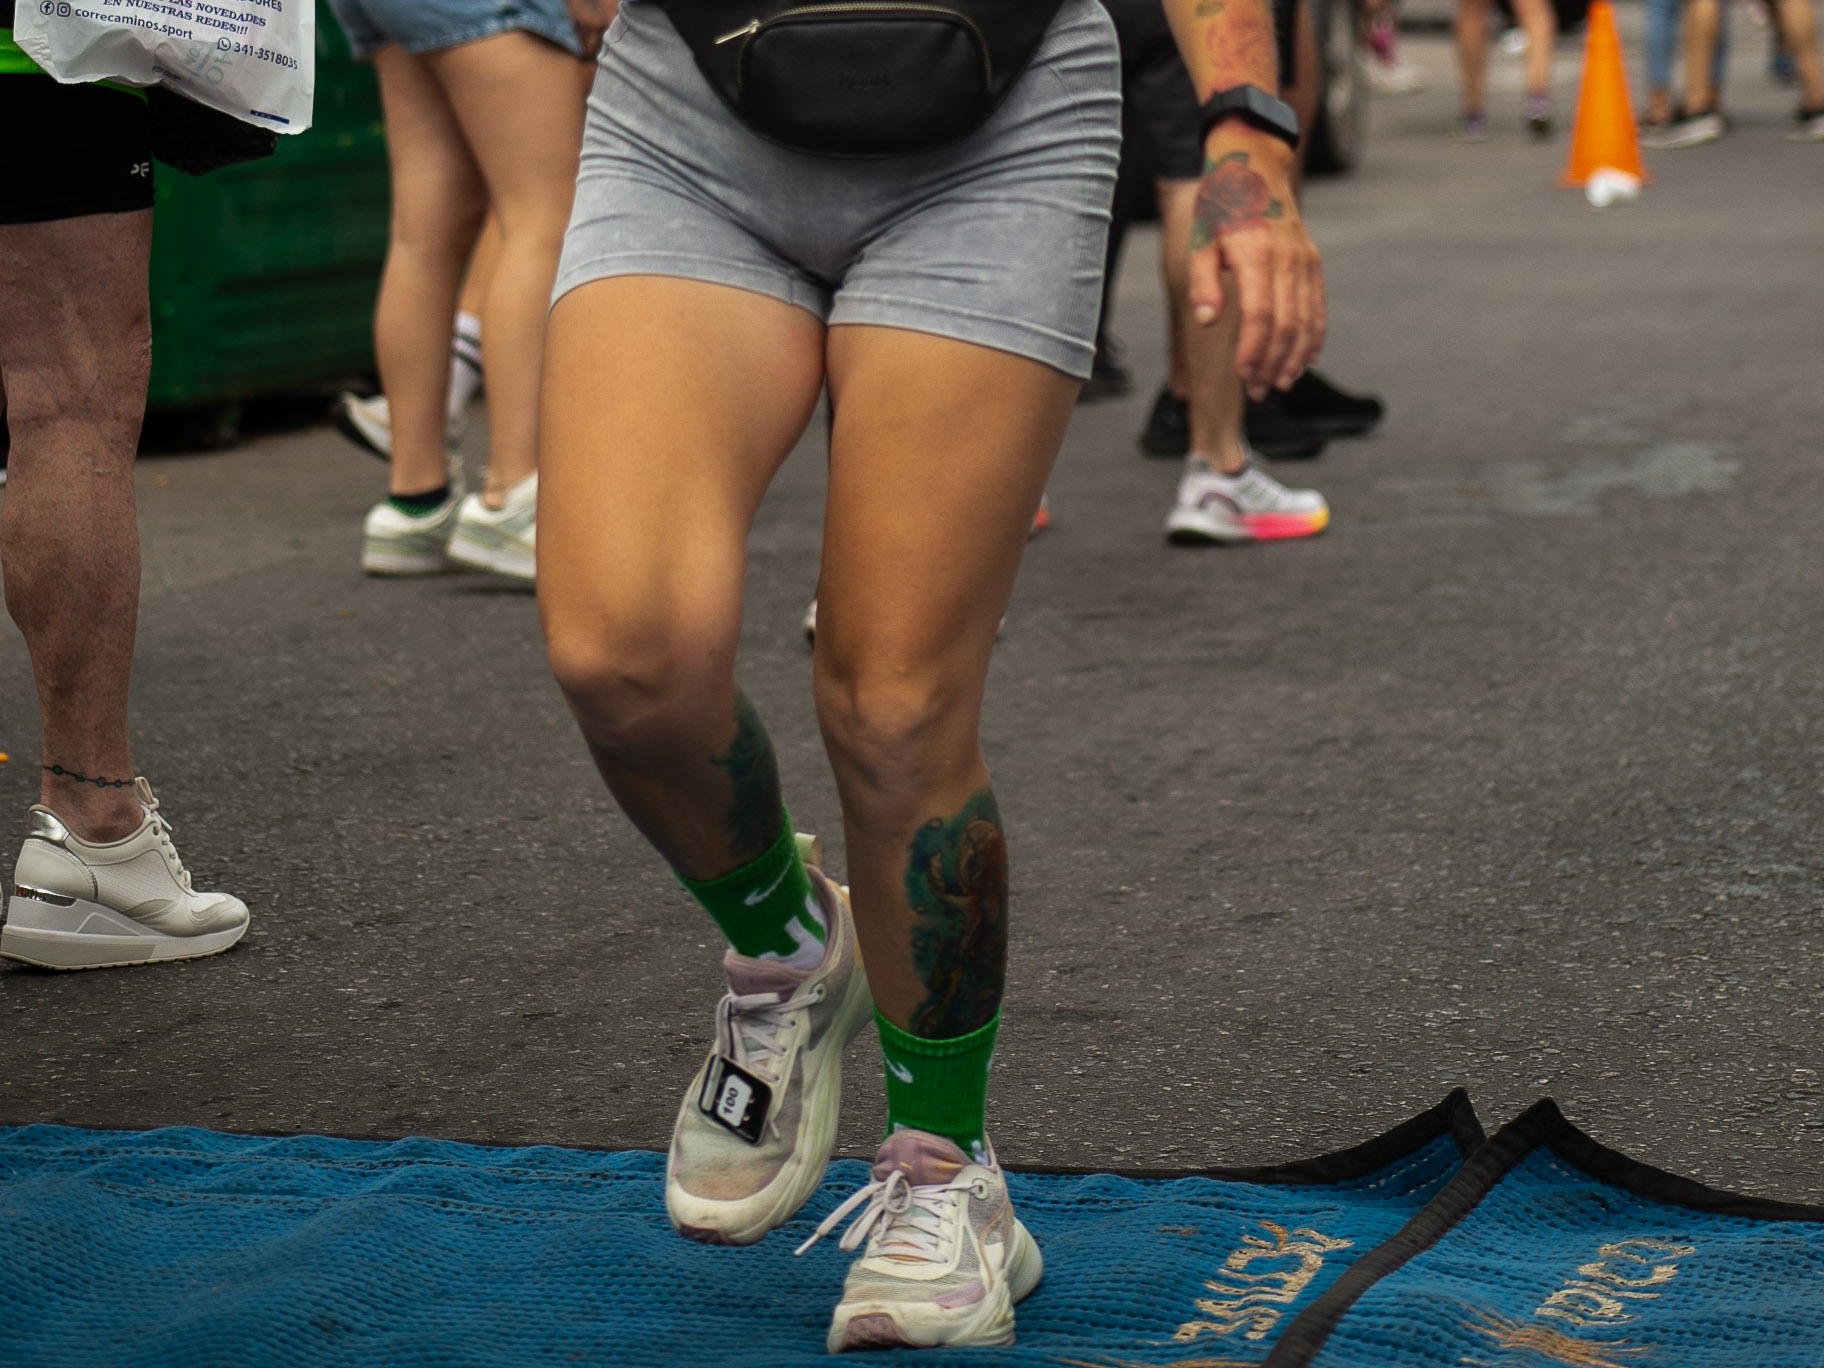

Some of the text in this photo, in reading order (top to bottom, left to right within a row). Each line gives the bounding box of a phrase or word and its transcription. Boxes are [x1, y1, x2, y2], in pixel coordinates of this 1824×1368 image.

[75, 8, 193, 40] correcaminos.sport
[125, 0, 193, 21] NUESTRAS
[195, 15, 249, 36] REDES!!!
[195, 2, 267, 27] NOVEDADES
[723, 1087, 739, 1114] 100
